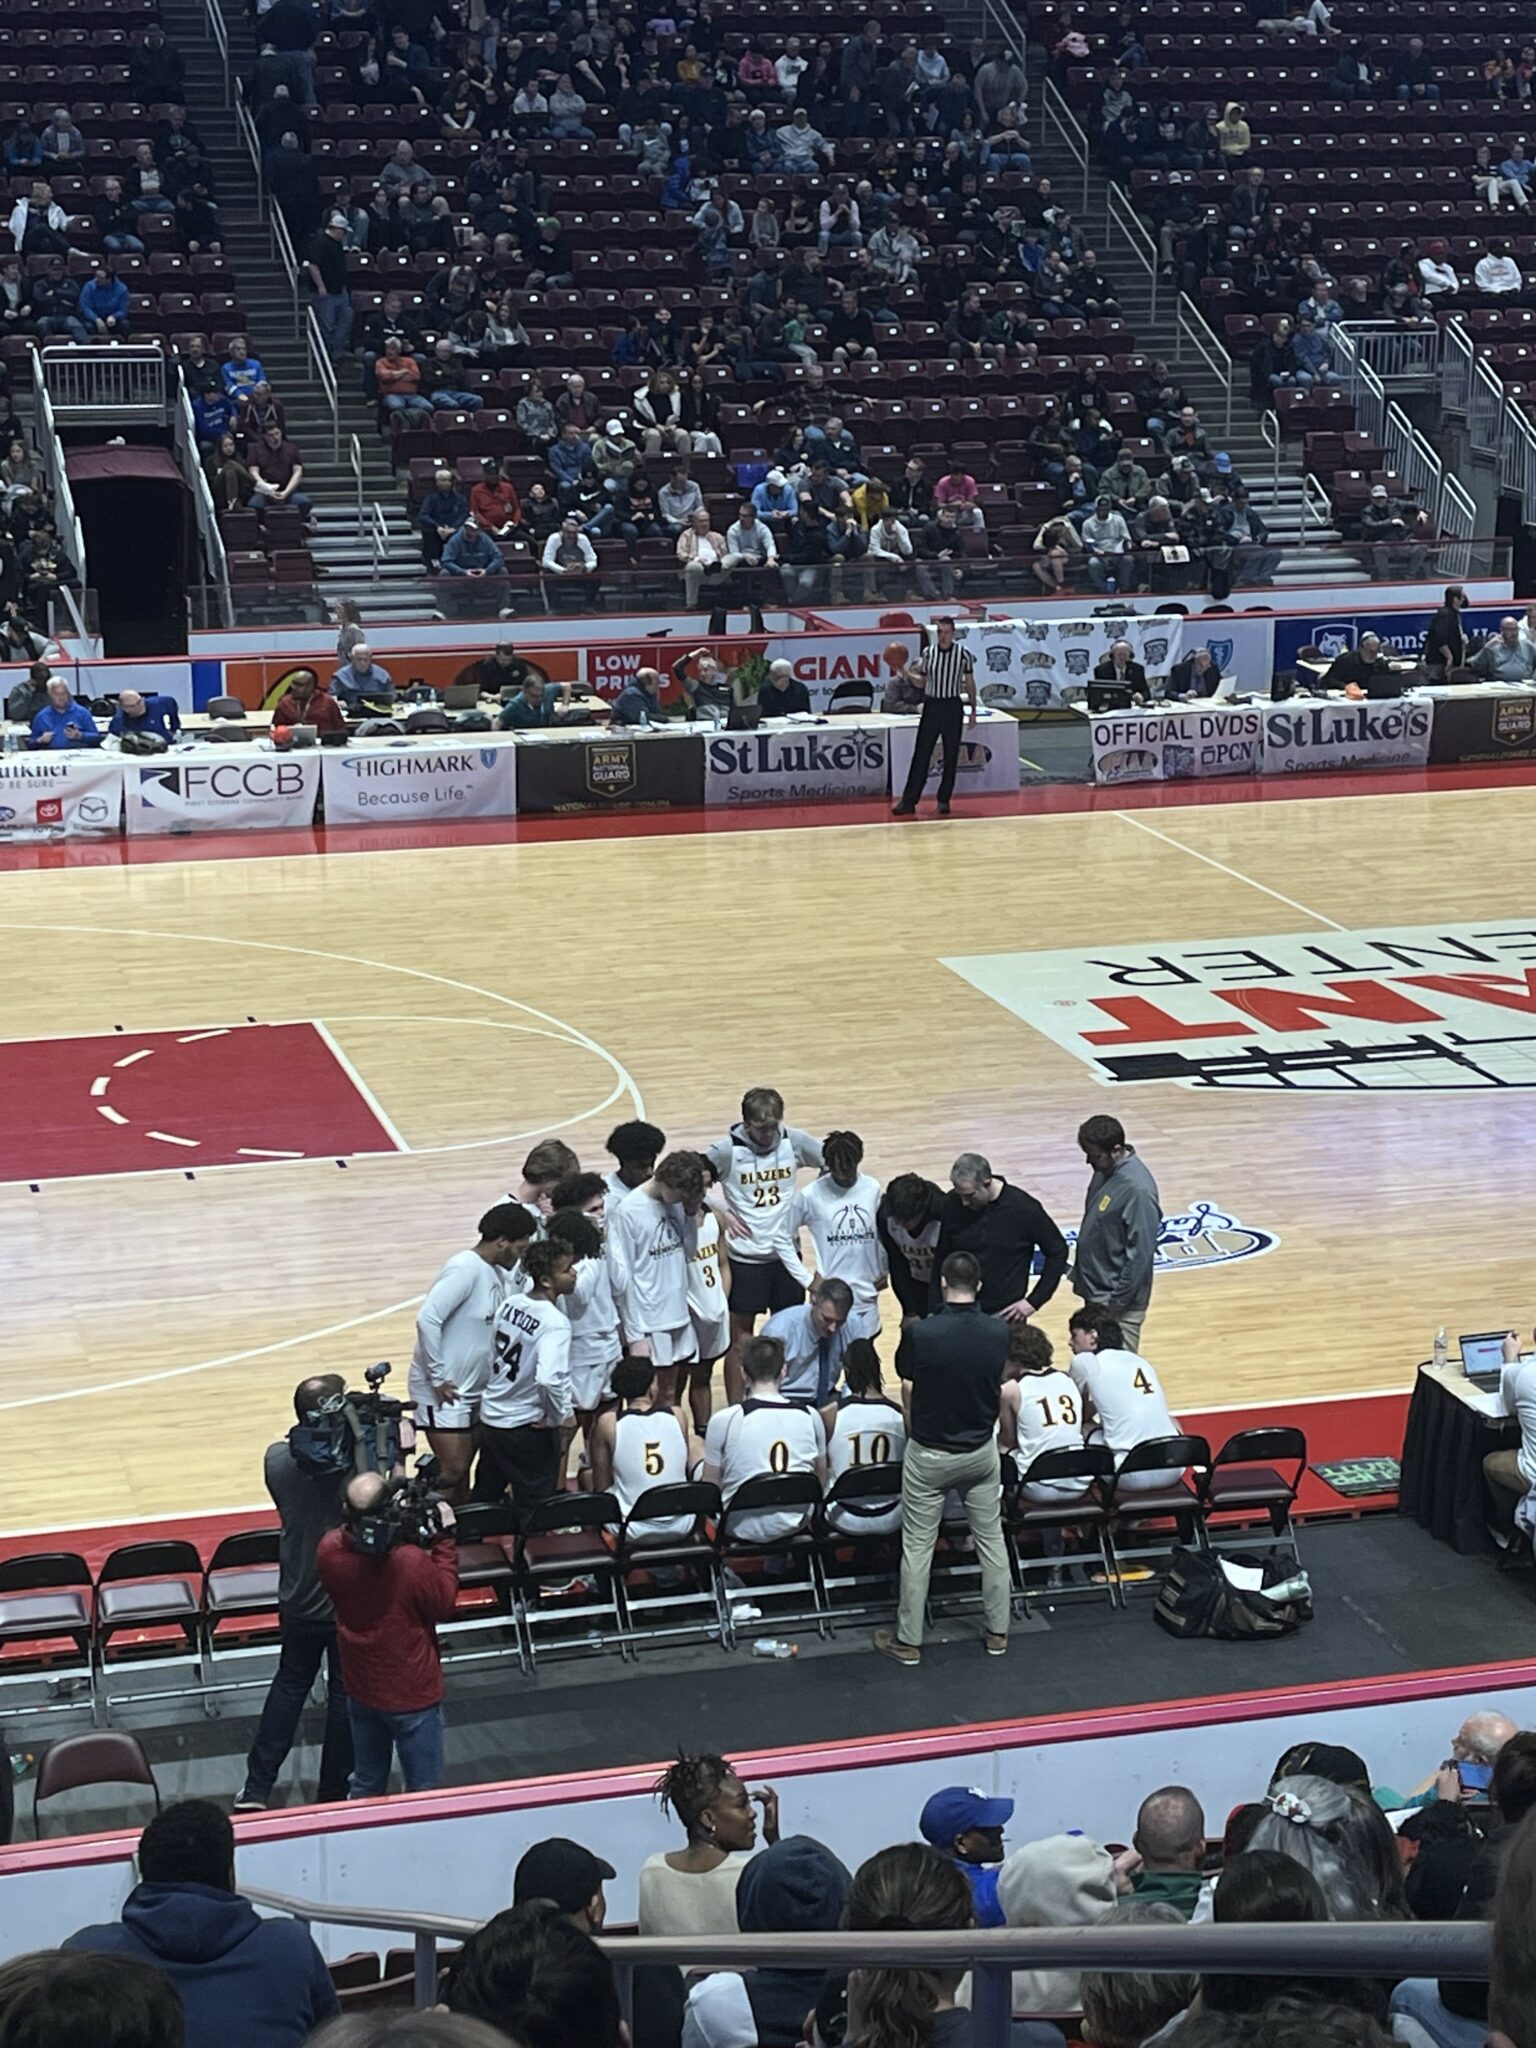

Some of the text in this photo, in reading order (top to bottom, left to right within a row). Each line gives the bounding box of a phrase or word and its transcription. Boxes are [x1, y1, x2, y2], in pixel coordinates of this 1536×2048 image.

[595, 654, 642, 671] LOW
[595, 673, 671, 690] PRIS
[1094, 714, 1259, 746] OFFICIAL DVDS
[1266, 703, 1429, 749] St Luke's
[593, 754, 629, 765] ARMY
[709, 729, 885, 775] St Luke's
[1216, 741, 1254, 763] PCN
[1284, 752, 1410, 772] Sports Medicine
[356, 754, 474, 777] HIGHMARK
[592, 770, 630, 782] GUARD
[184, 763, 304, 799] FCCB
[727, 783, 867, 802] Sports Medicine
[358, 789, 430, 806] Because
[740, 1166, 792, 1185] BLAZERS
[753, 1185, 781, 1208] 23
[702, 1265, 716, 1288] 3
[1132, 1367, 1155, 1396] 4
[1036, 1394, 1078, 1428] 13
[644, 1441, 665, 1475] 5
[769, 1440, 790, 1473] 0
[848, 1433, 891, 1466] 10
